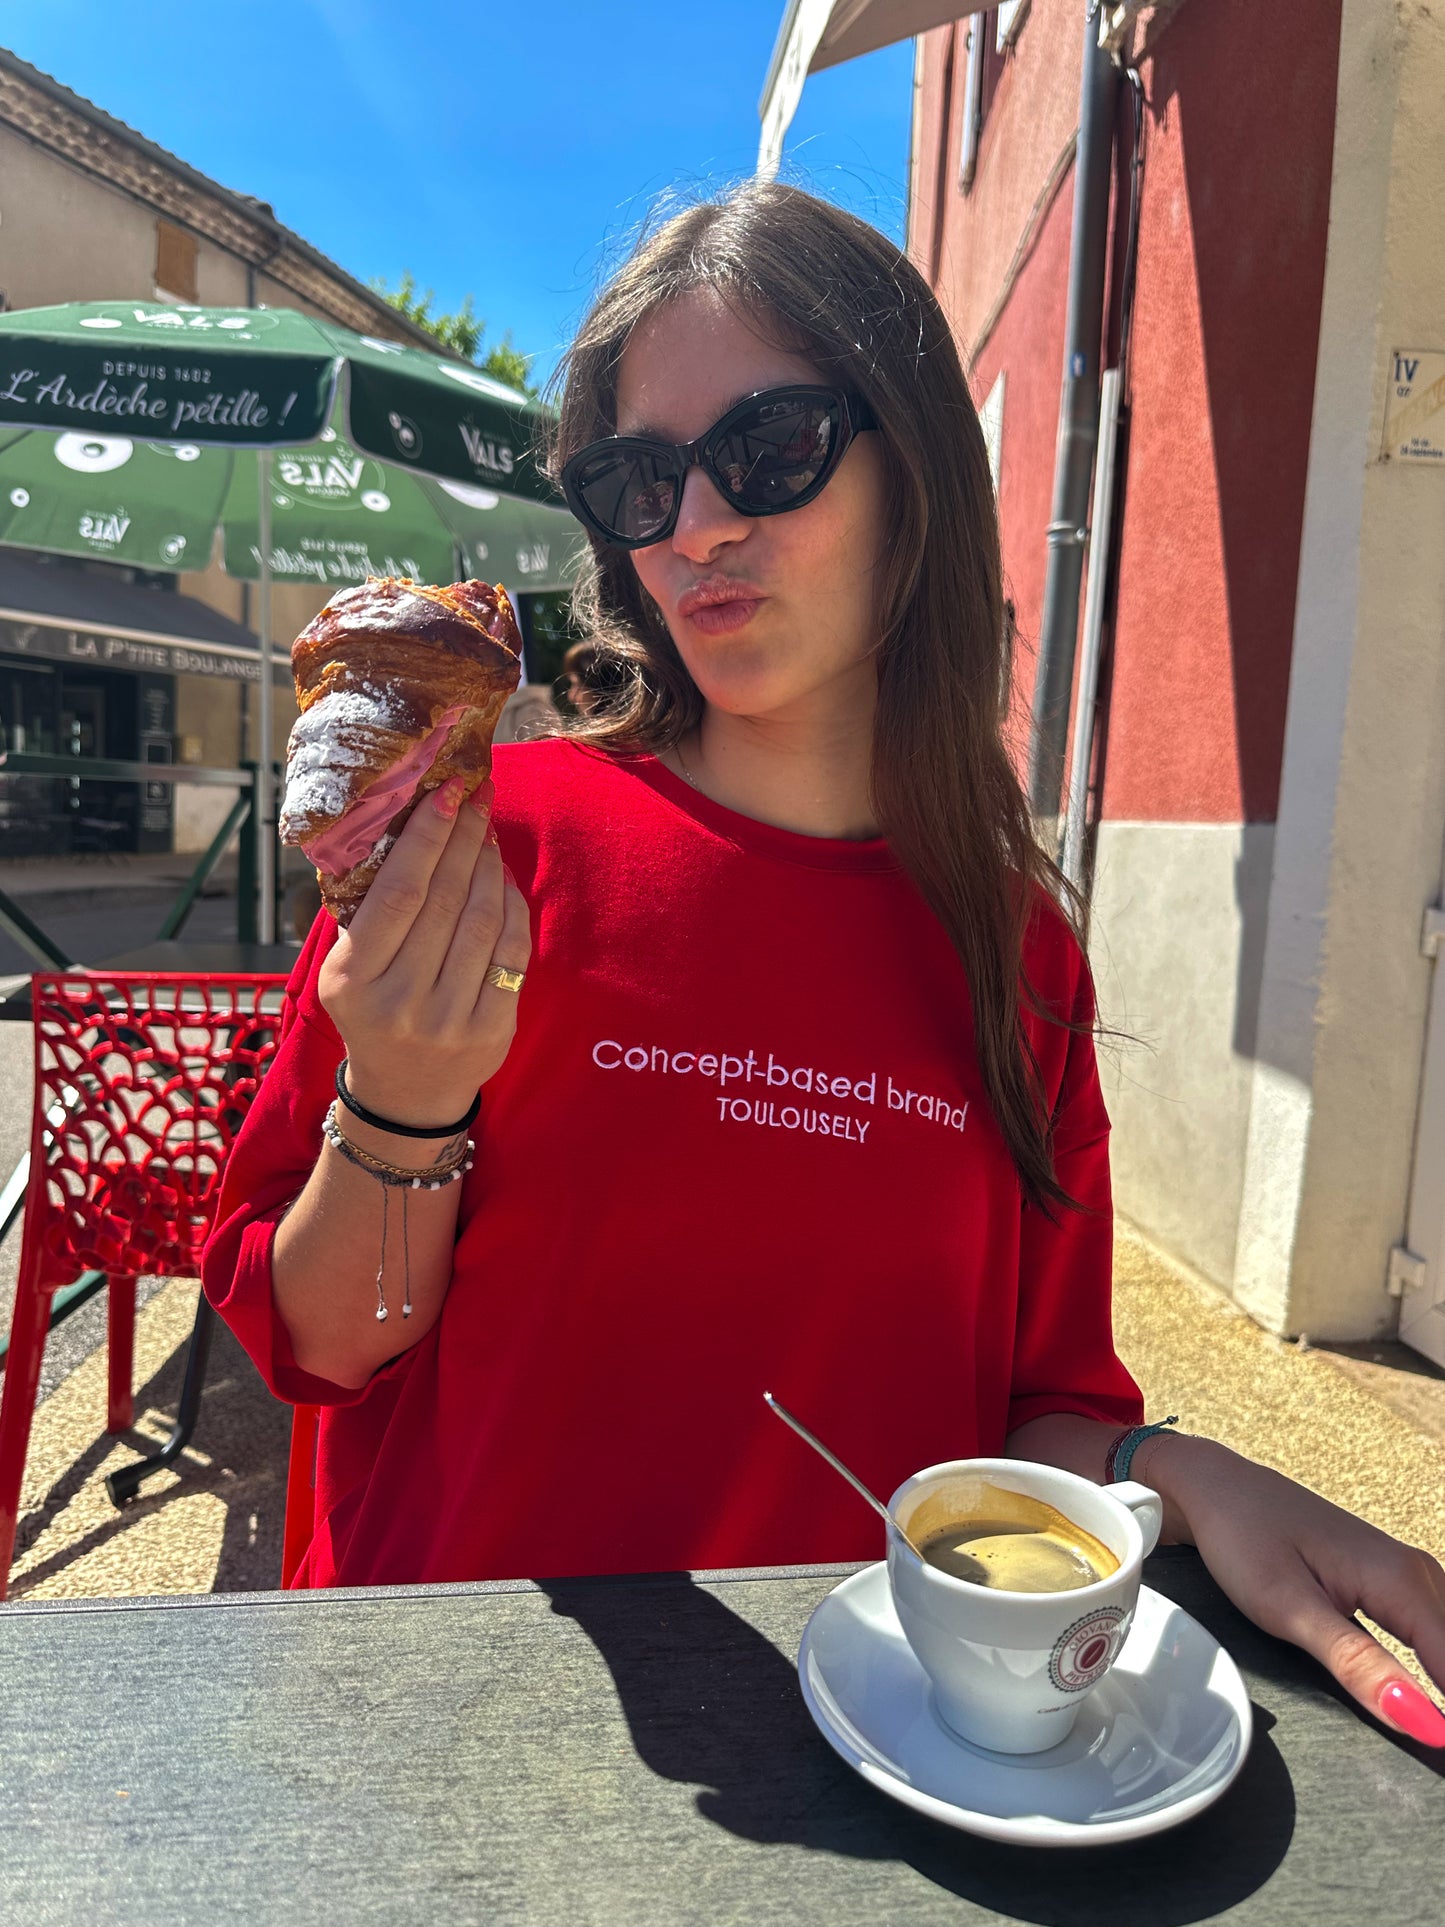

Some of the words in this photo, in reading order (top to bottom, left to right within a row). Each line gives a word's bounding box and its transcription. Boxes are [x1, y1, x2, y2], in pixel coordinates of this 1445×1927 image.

[102, 359, 167, 381] DEPUIS
[1394, 358, 1420, 382] IV
[0, 367, 169, 419] L'Ardèche
[169, 388, 271, 431] pétille
[276, 390, 299, 427] !
[458, 422, 515, 475] VALS
[67, 631, 98, 658] LA
[102, 638, 169, 668] P'TITE
[592, 1039, 876, 1105] Concept-based
[886, 1076, 970, 1133] brand
[716, 1096, 871, 1144] TOULOUSELY
